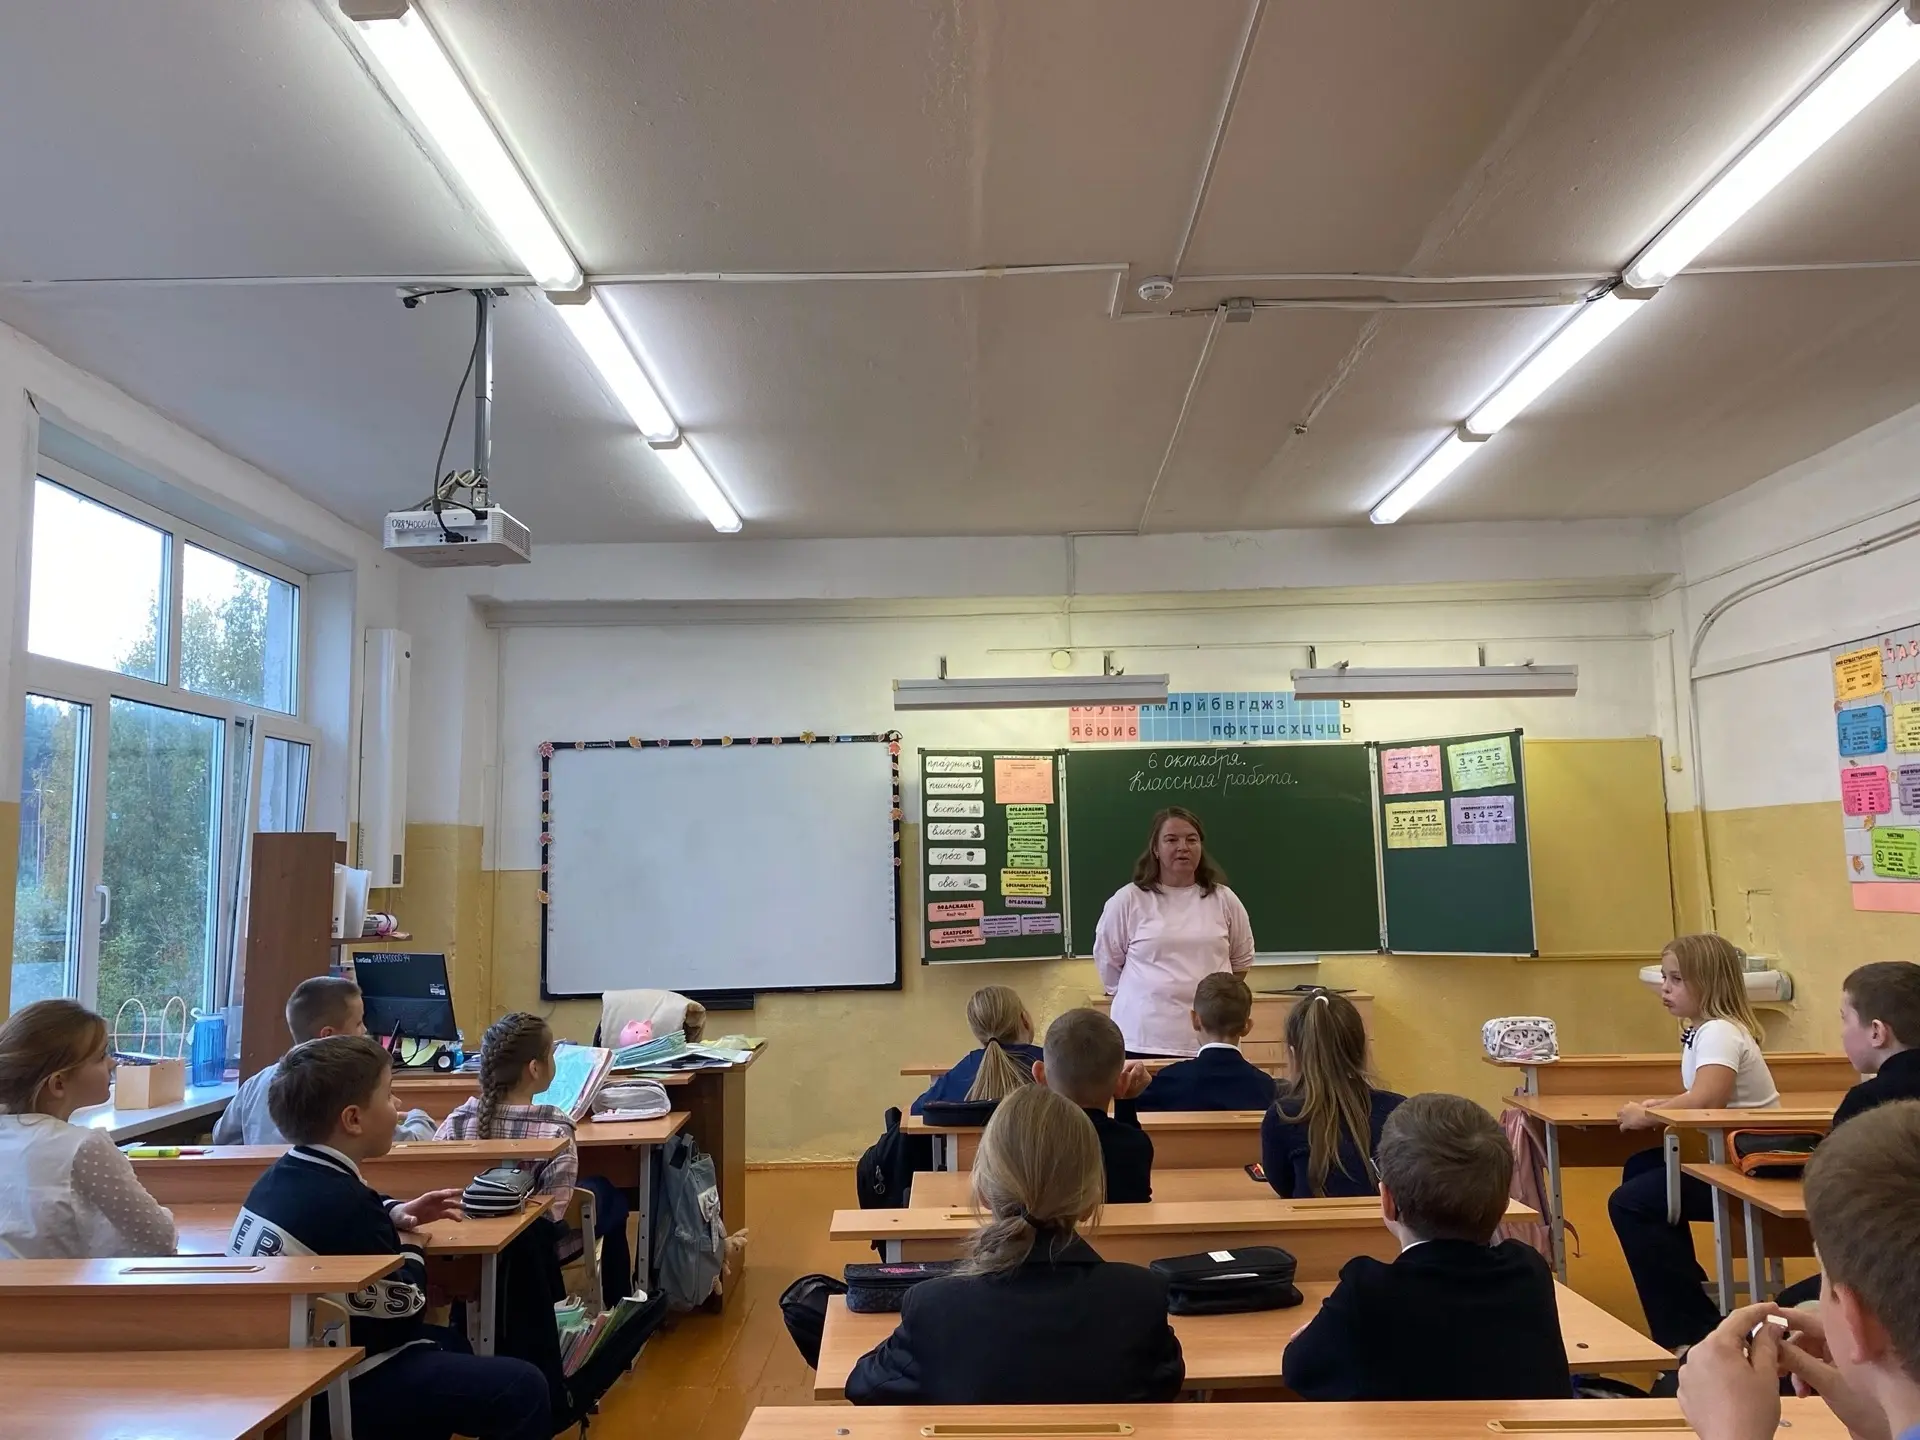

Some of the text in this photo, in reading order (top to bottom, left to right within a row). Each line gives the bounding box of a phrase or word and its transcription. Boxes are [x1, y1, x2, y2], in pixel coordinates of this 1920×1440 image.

[1169, 701, 1178, 711] л
[1183, 701, 1191, 713] р
[1198, 698, 1206, 711] й
[1212, 697, 1220, 710] б
[1226, 700, 1234, 710] в
[1239, 700, 1245, 709] г
[1249, 700, 1259, 712] д
[1262, 700, 1273, 709] ж
[1276, 700, 1284, 709] з
[1148, 748, 1246, 779] 6 октября.
[1392, 762, 1399, 770] 4
[1423, 760, 1429, 768] 3
[1460, 758, 1466, 766] 3
[1477, 755, 1483, 764] 2
[1494, 752, 1501, 760] 5
[1129, 764, 1298, 797] Классная работа.
[1426, 814, 1437, 822] 12
[1464, 812, 1470, 820] 8
[1479, 810, 1485, 818] 4
[1496, 810, 1503, 818] 2
